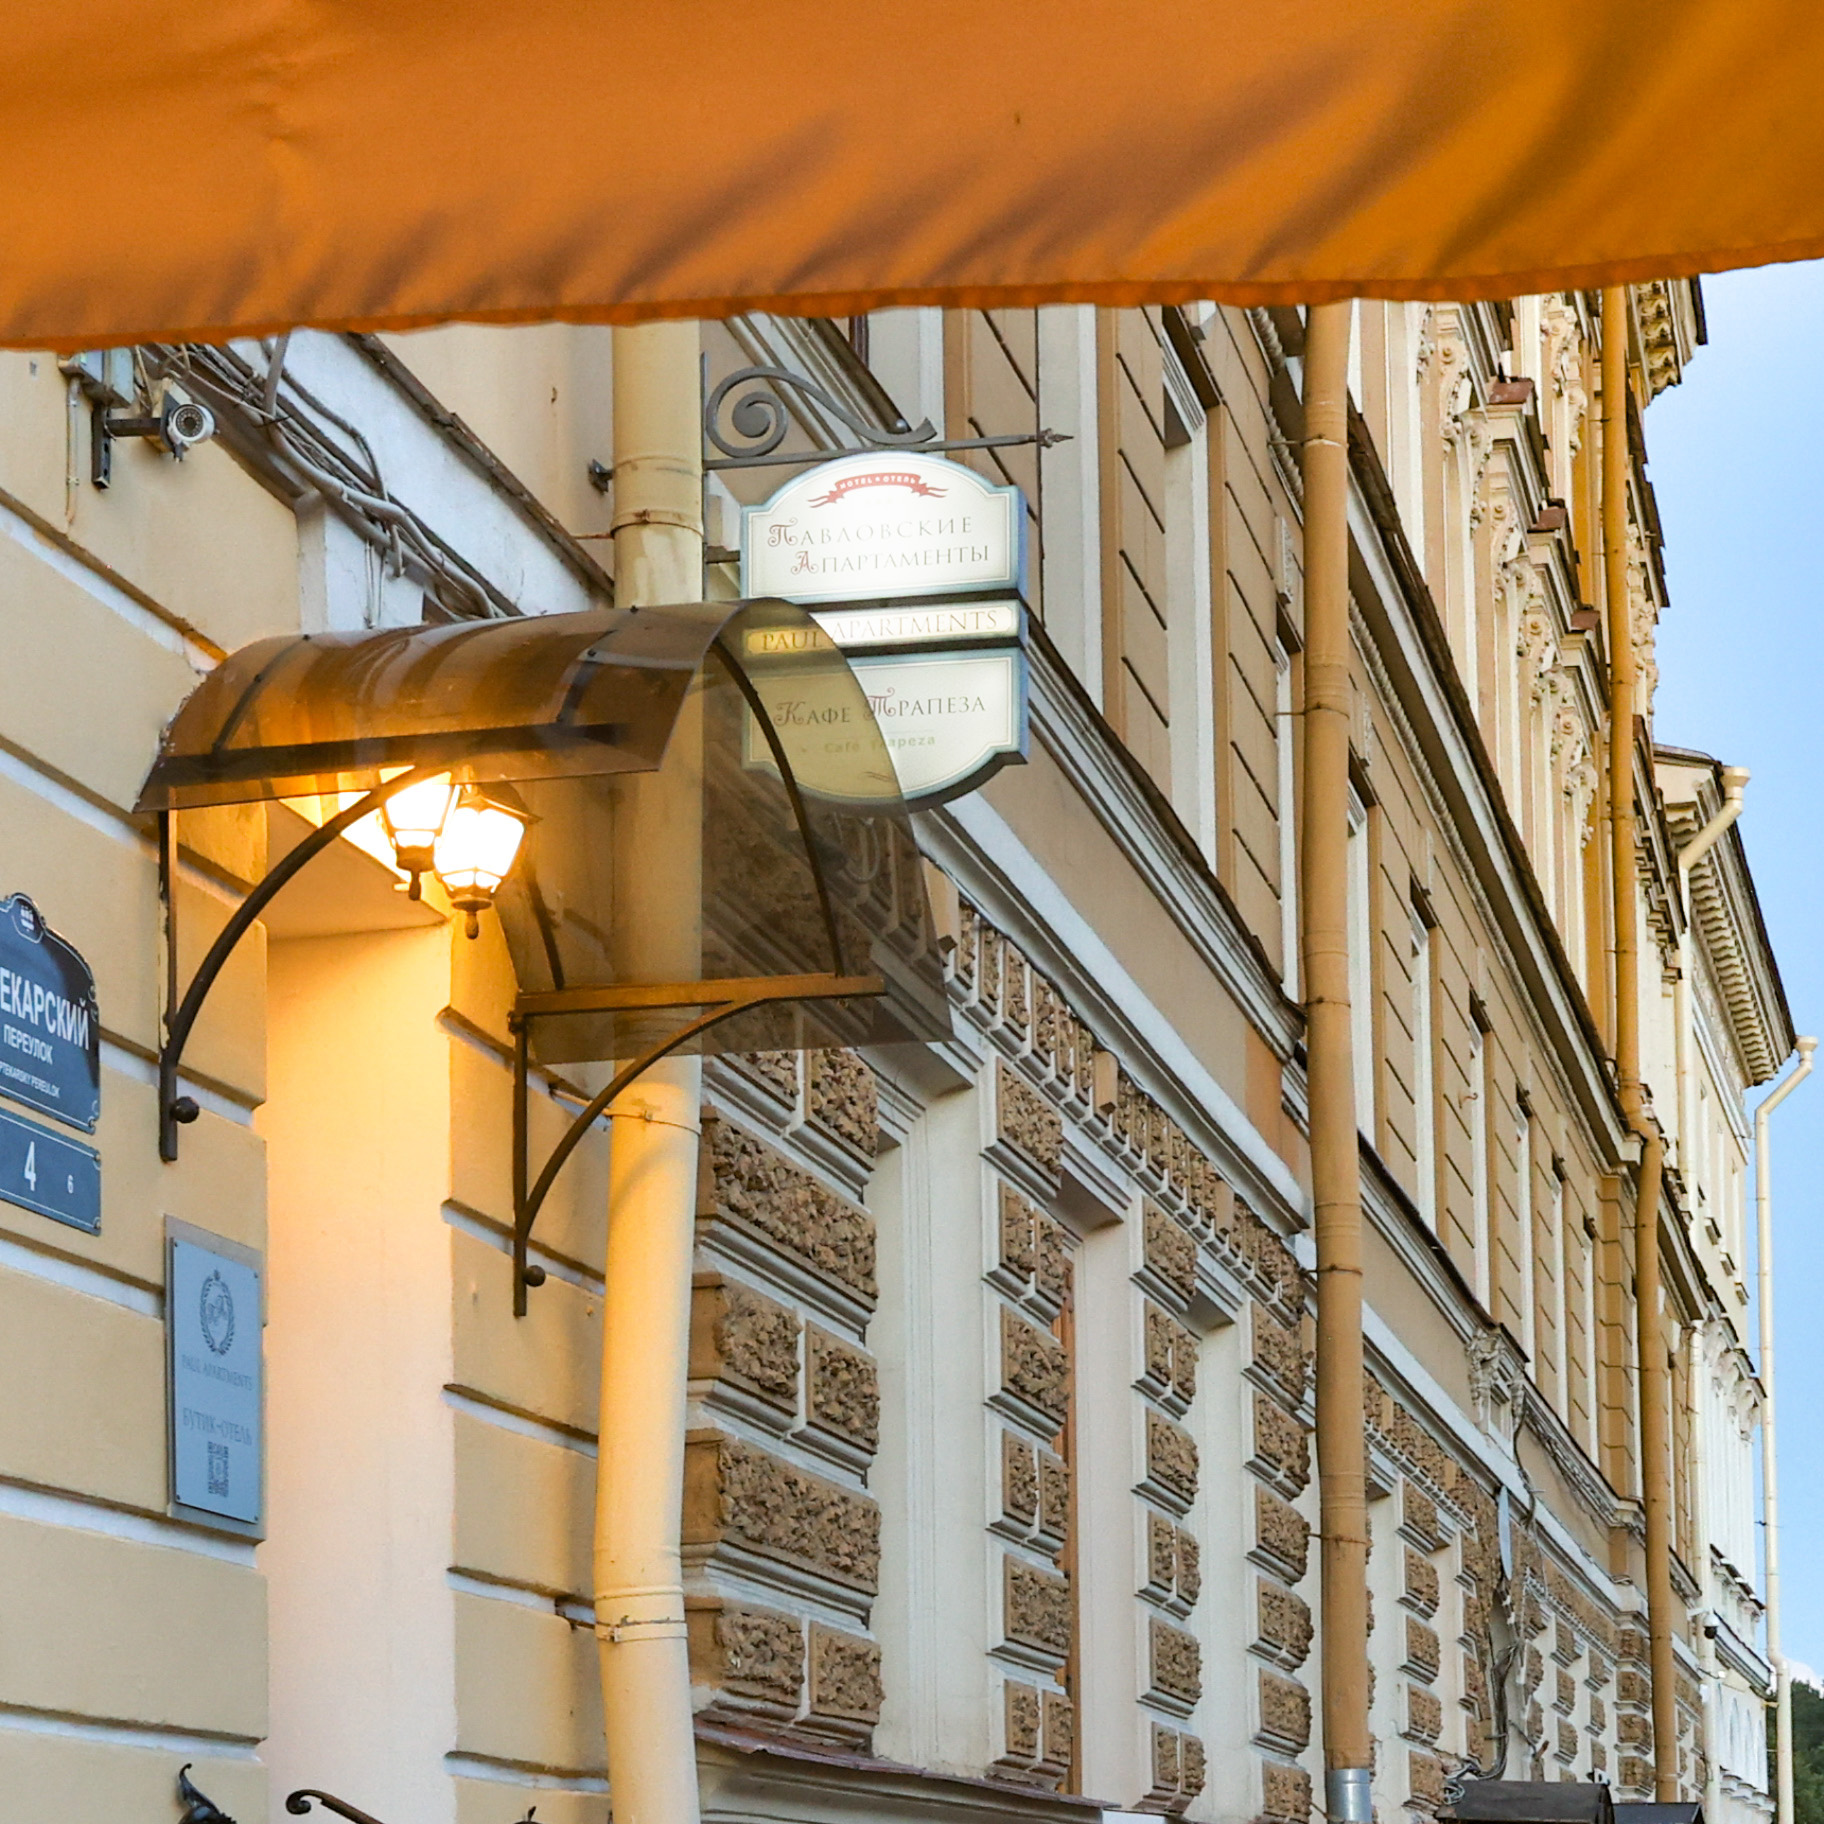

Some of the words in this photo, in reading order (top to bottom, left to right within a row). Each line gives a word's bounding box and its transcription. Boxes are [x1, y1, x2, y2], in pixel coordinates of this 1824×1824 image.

[790, 545, 989, 576] АПАРТАМЕНТЫ
[831, 610, 999, 641] APARTMENTS
[3, 1023, 53, 1065] ПЕРЕУЛОК
[24, 1141, 36, 1192] 4
[67, 1174, 74, 1194] 6
